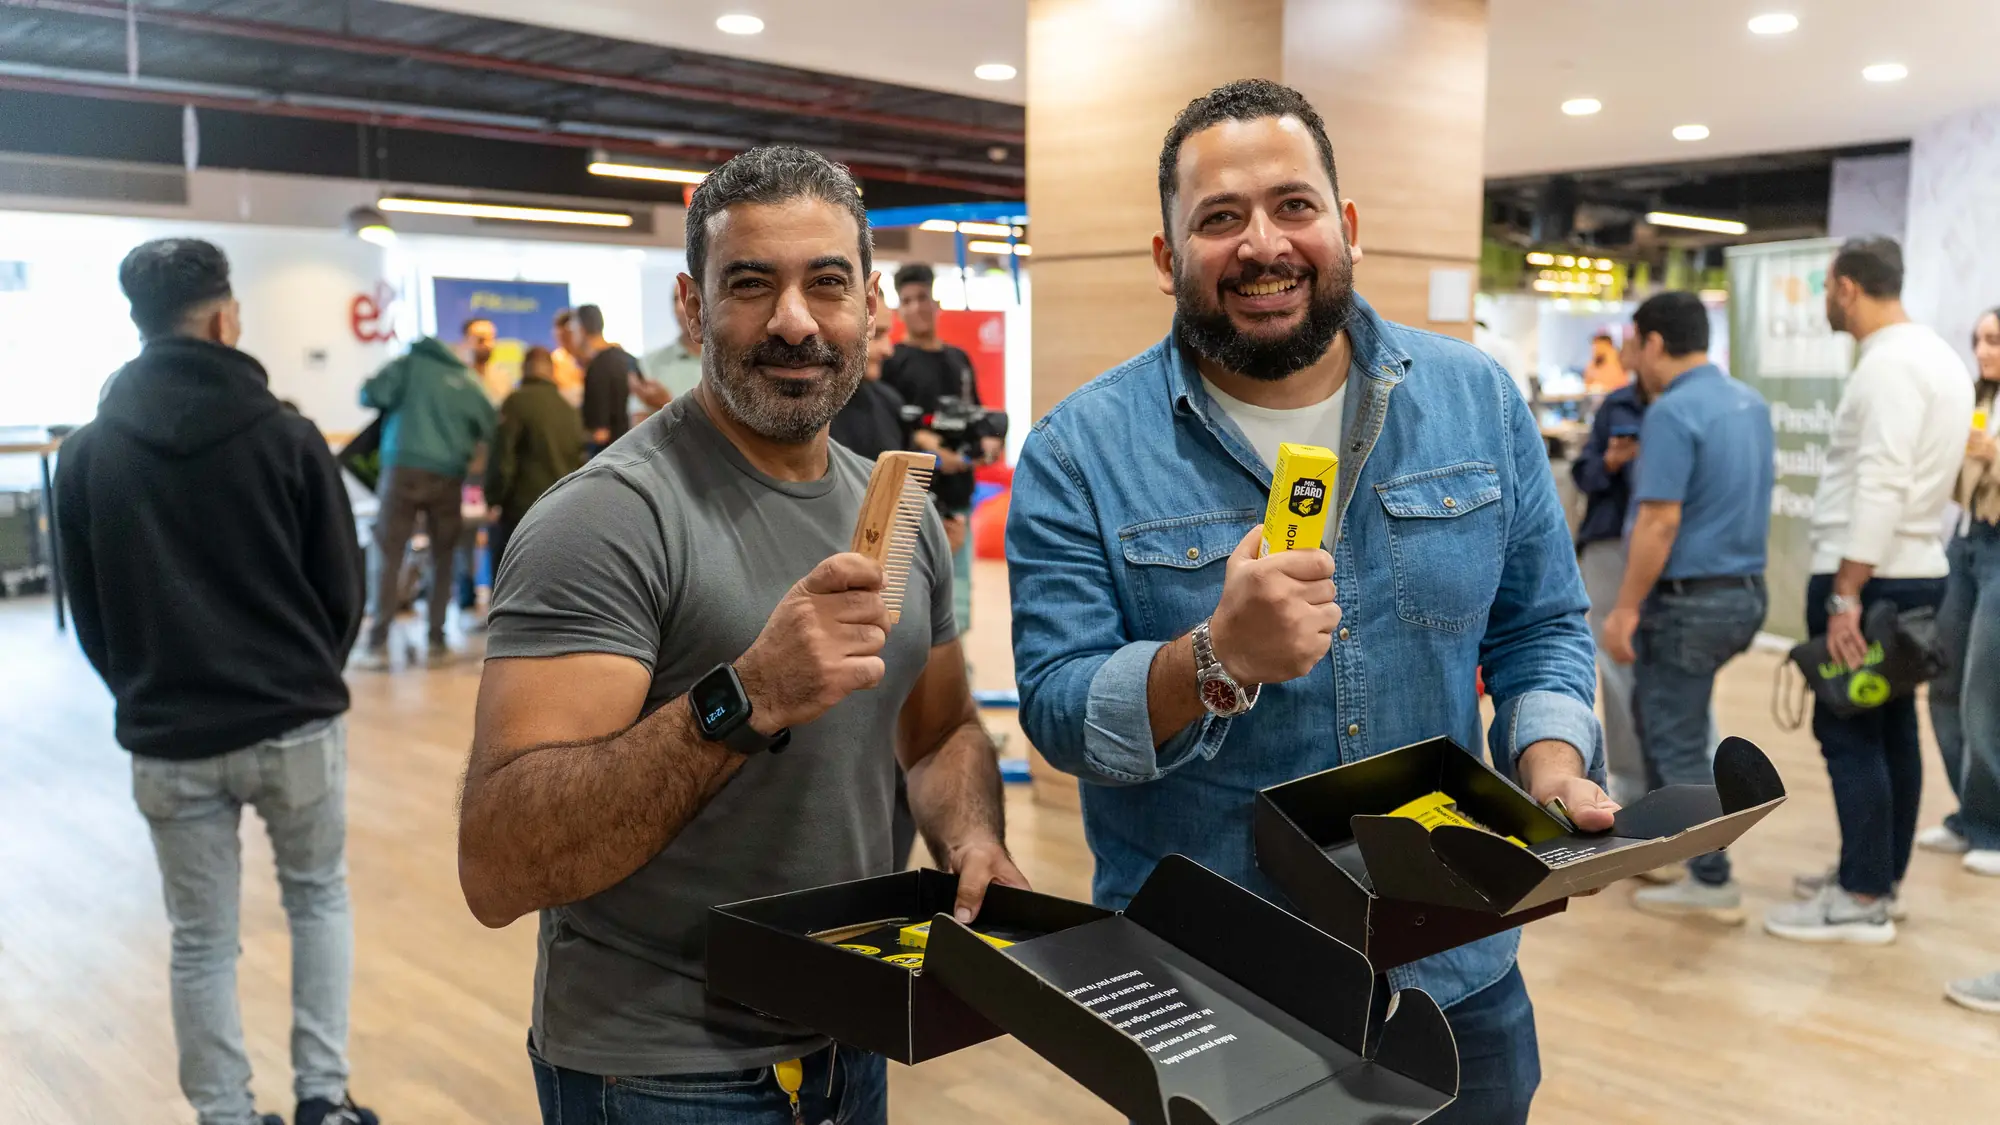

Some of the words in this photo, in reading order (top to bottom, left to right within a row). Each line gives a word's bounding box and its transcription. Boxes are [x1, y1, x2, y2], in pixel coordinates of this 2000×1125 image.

[1294, 486, 1322, 498] BEARD
[1287, 524, 1298, 538] Oil
[705, 706, 726, 724] 12:21
[1109, 969, 1143, 982] because
[1086, 978, 1112, 990] you're
[1133, 981, 1155, 990] Take
[1108, 992, 1119, 1000] of
[1117, 987, 1135, 996] care
[1147, 991, 1166, 1001] your
[1163, 987, 1179, 997] and
[1081, 994, 1111, 1007] yourse
[1165, 1001, 1187, 1011] keep
[1108, 998, 1149, 1015] confidence
[1149, 1006, 1168, 1017] your
[1198, 1008, 1214, 1016] Mr.
[1130, 1013, 1151, 1023] edge
[1177, 1012, 1202, 1025] Beard
[1153, 1022, 1175, 1032] here
[1196, 1023, 1217, 1034] walk
[1132, 1032, 1149, 1041] hel
[1181, 1028, 1201, 1040] your
[1213, 1033, 1237, 1044] Make
[1165, 1035, 1184, 1046] own
[1198, 1039, 1217, 1051] your
[1181, 1047, 1200, 1057] own
[1159, 1053, 1185, 1065] rules,
